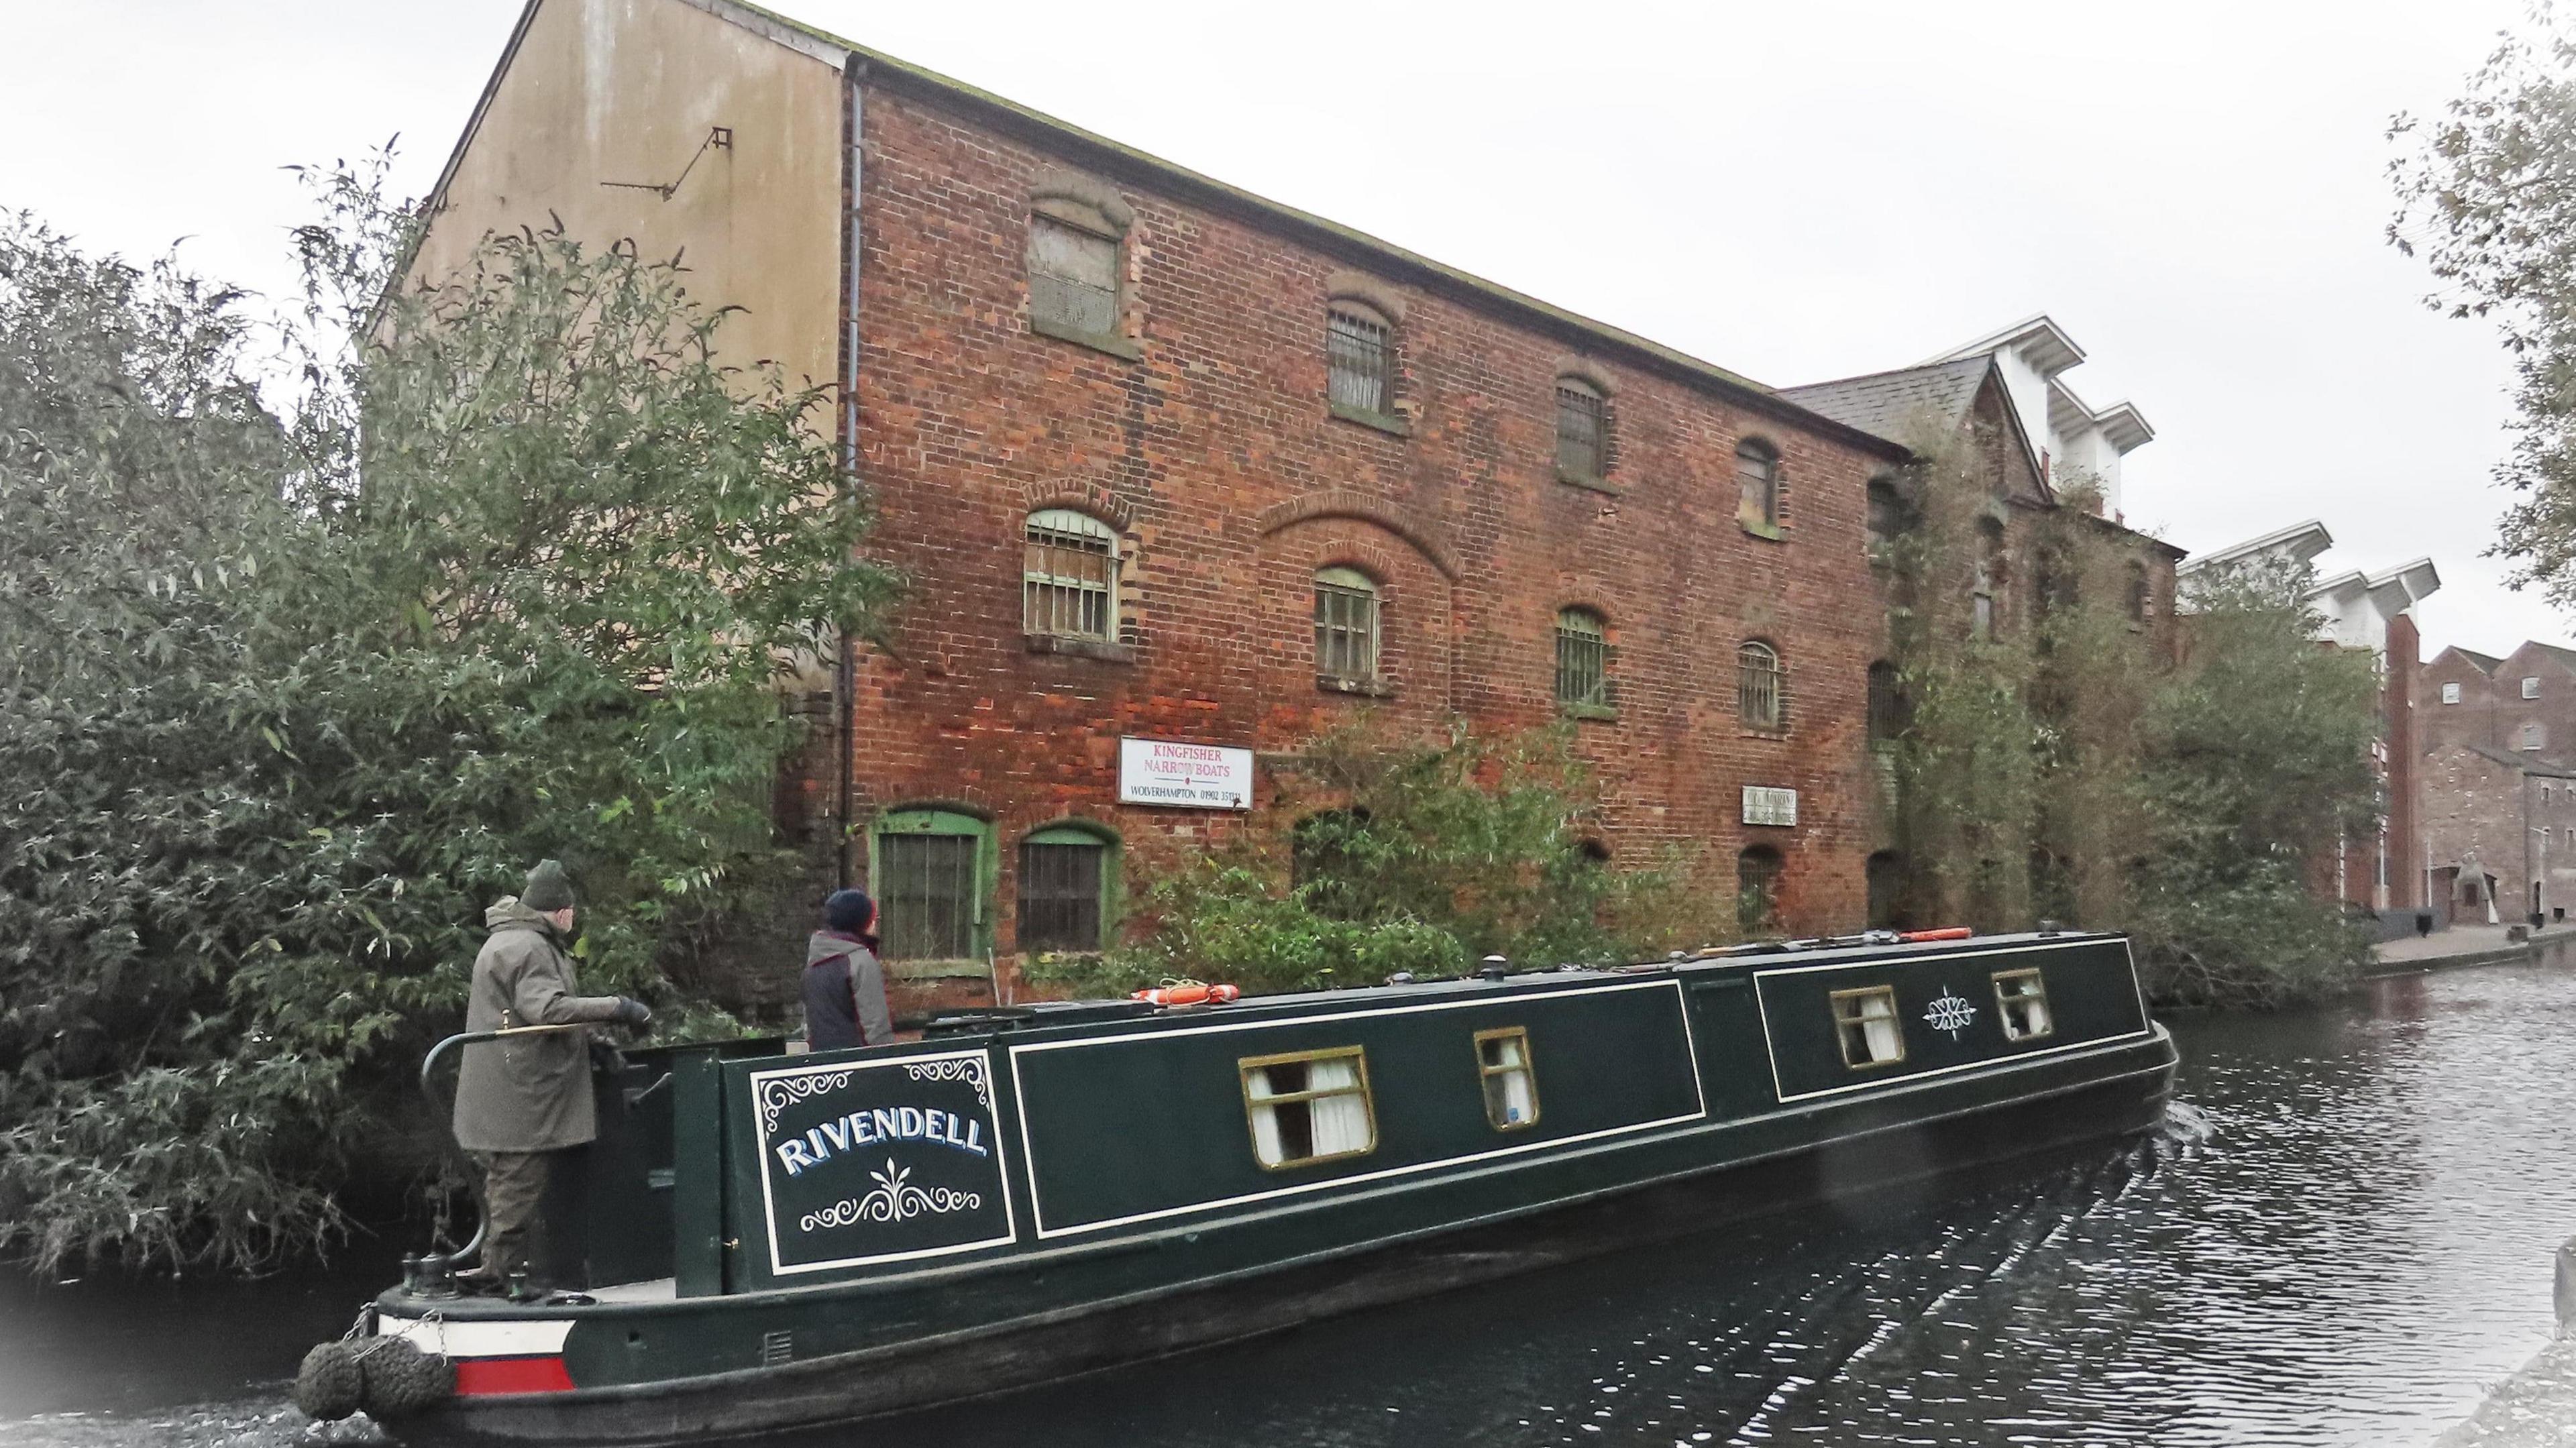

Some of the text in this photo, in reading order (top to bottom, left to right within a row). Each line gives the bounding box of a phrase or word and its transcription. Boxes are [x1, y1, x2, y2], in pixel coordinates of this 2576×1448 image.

[1153, 744, 1222, 762] KINGFISHER
[1131, 785, 1196, 799] WOLVERHAMPTON
[1200, 790, 1219, 800] 01902
[775, 1107, 987, 1178] RIVENDELL
